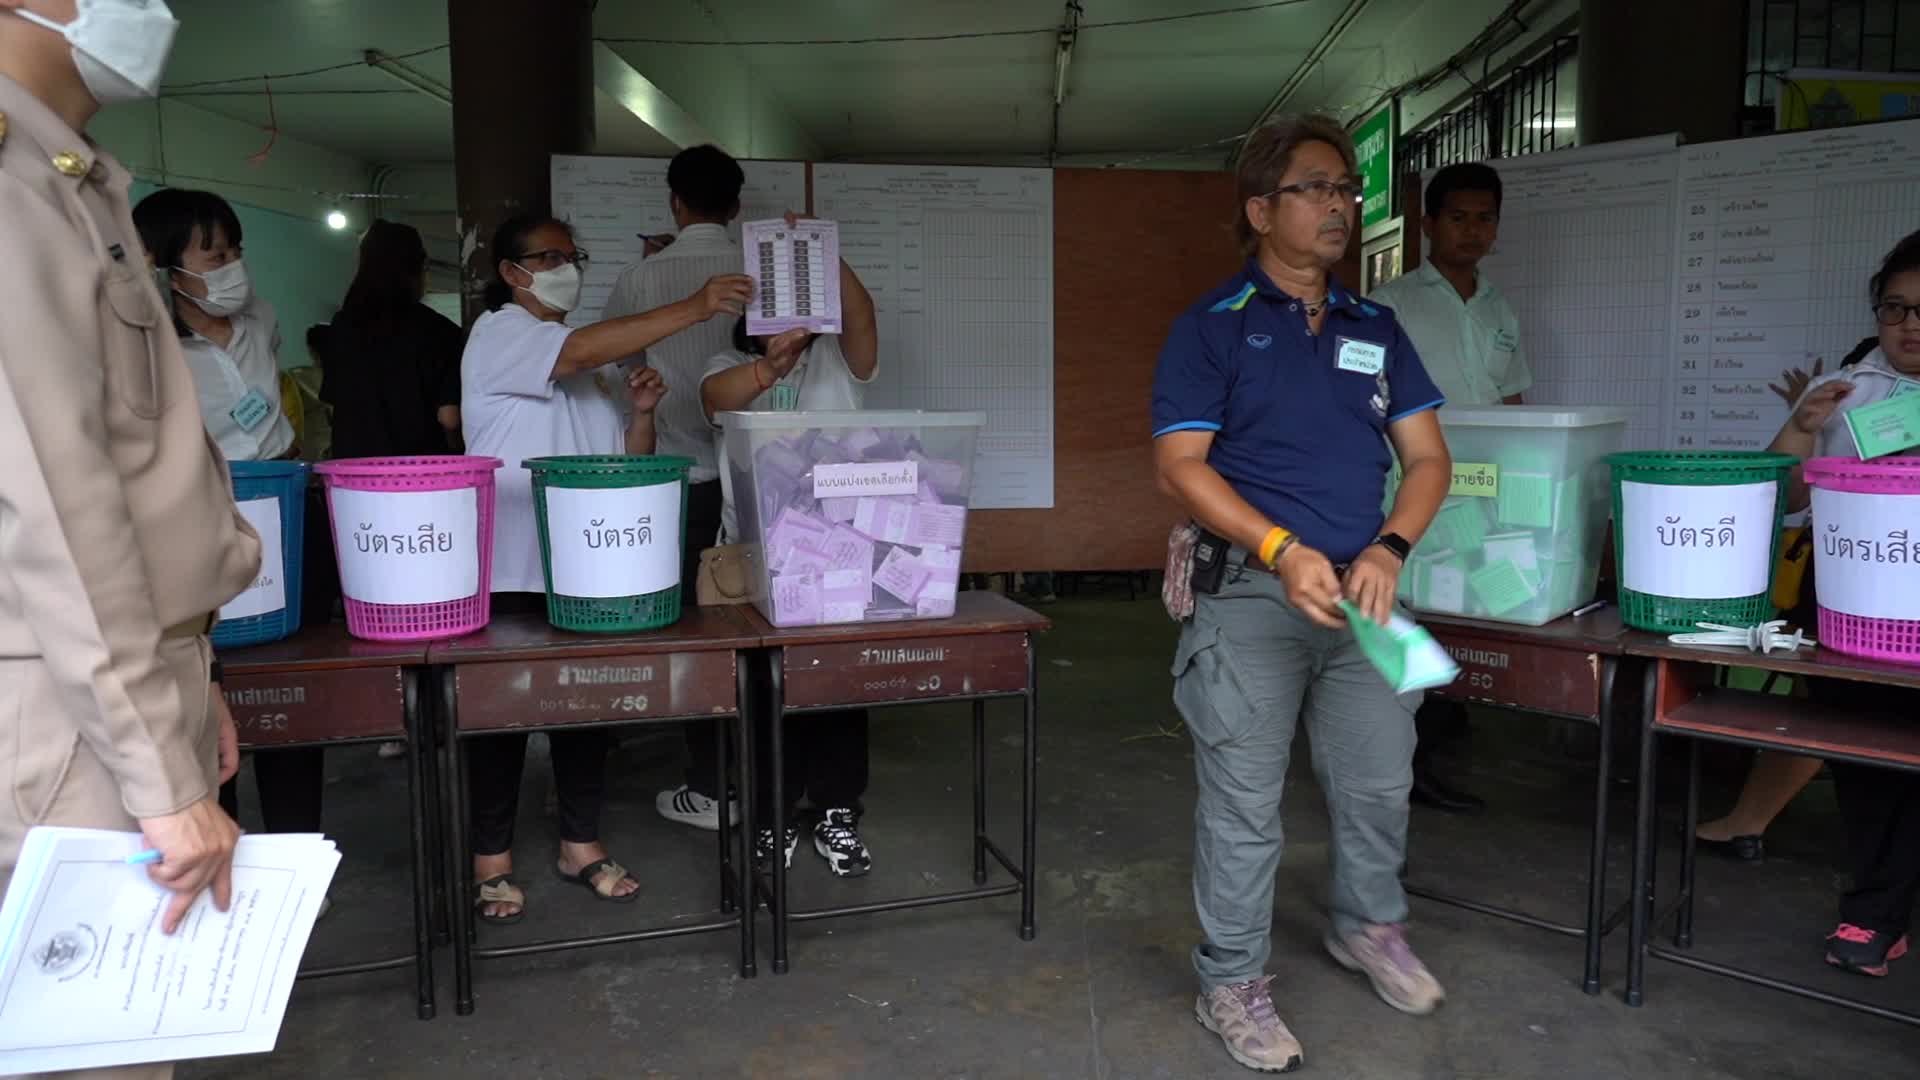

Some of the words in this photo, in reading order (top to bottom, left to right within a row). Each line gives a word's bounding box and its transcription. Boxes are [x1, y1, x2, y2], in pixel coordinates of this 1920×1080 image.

[1691, 205, 1706, 215] 25
[1688, 231, 1704, 241] 26
[1687, 256, 1703, 267] 27
[1687, 282, 1702, 293] 28
[1684, 309, 1701, 319] 29
[1682, 334, 1700, 344] 30
[1681, 360, 1697, 370] 31
[1681, 385, 1697, 395] 32
[583, 514, 652, 548] บัตรดี
[1656, 515, 1735, 547] บัตรดี
[353, 522, 453, 554] บัตรเสีย
